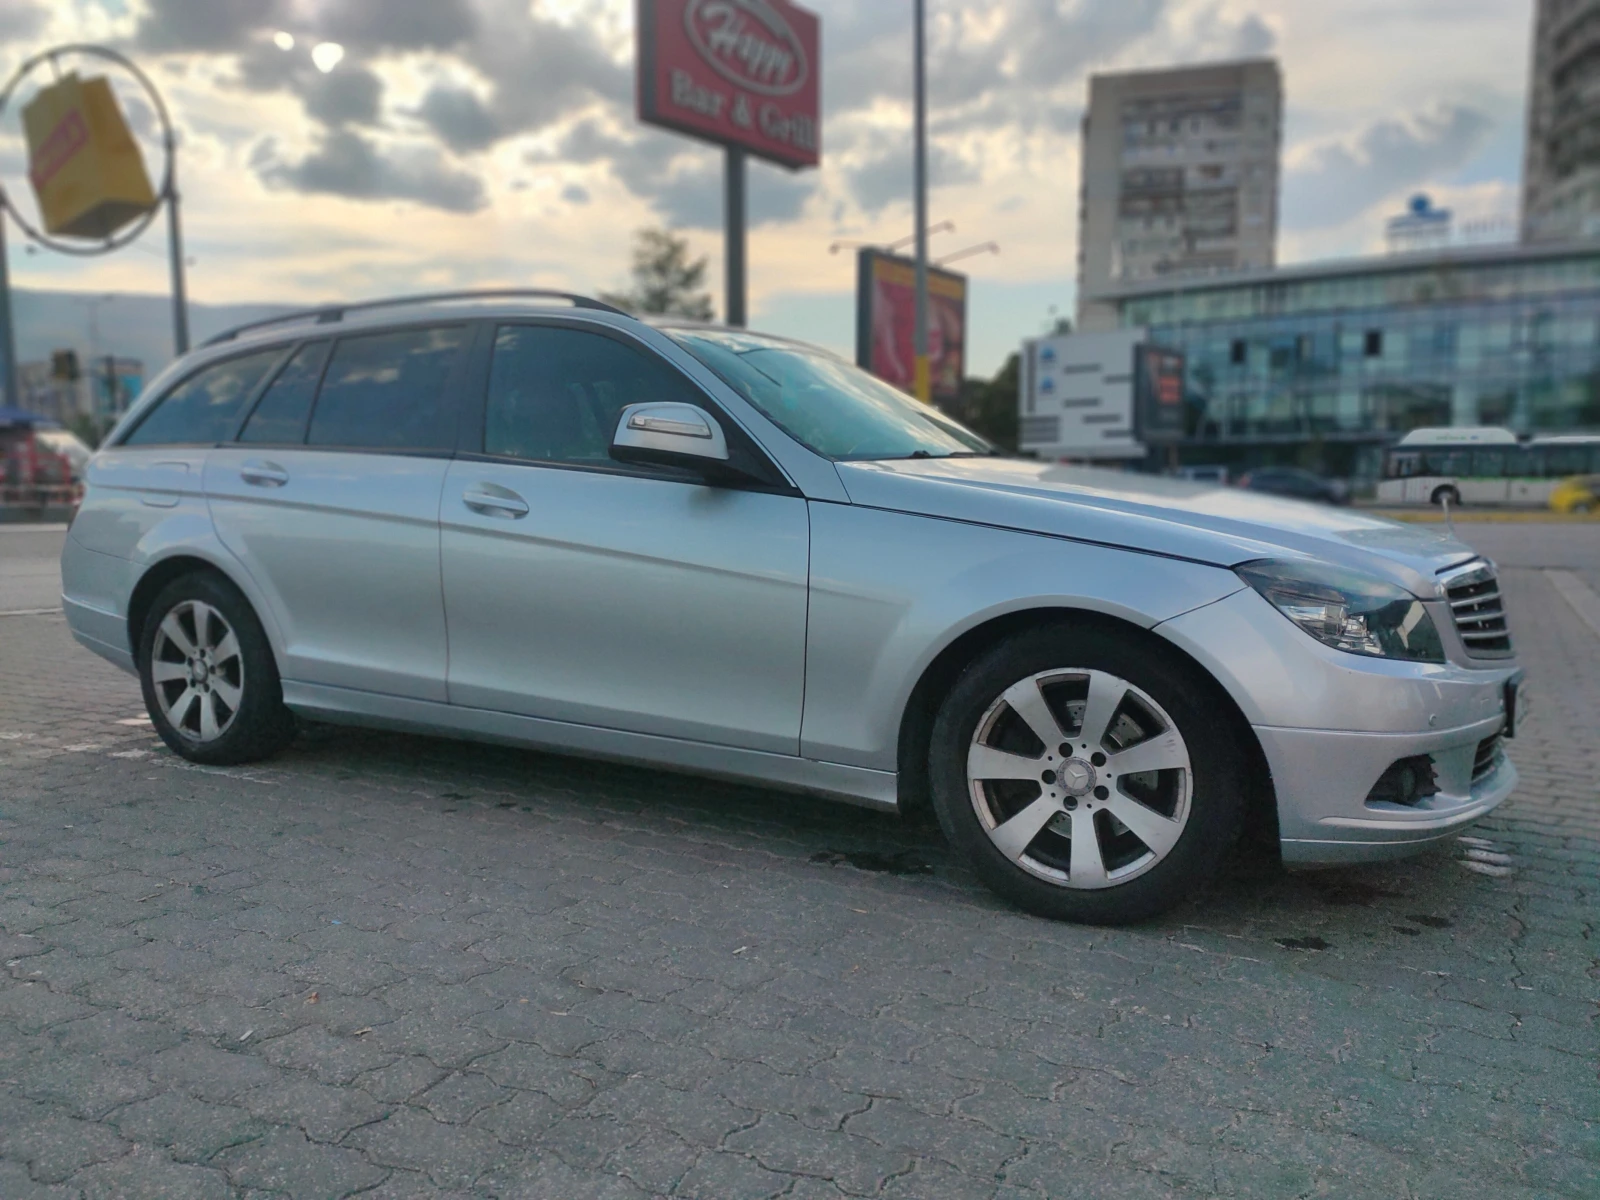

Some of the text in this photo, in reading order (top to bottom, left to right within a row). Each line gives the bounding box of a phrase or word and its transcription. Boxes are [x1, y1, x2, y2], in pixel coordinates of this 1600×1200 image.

[701, 2, 793, 84] Happy
[670, 69, 816, 148] Bar & Grill
